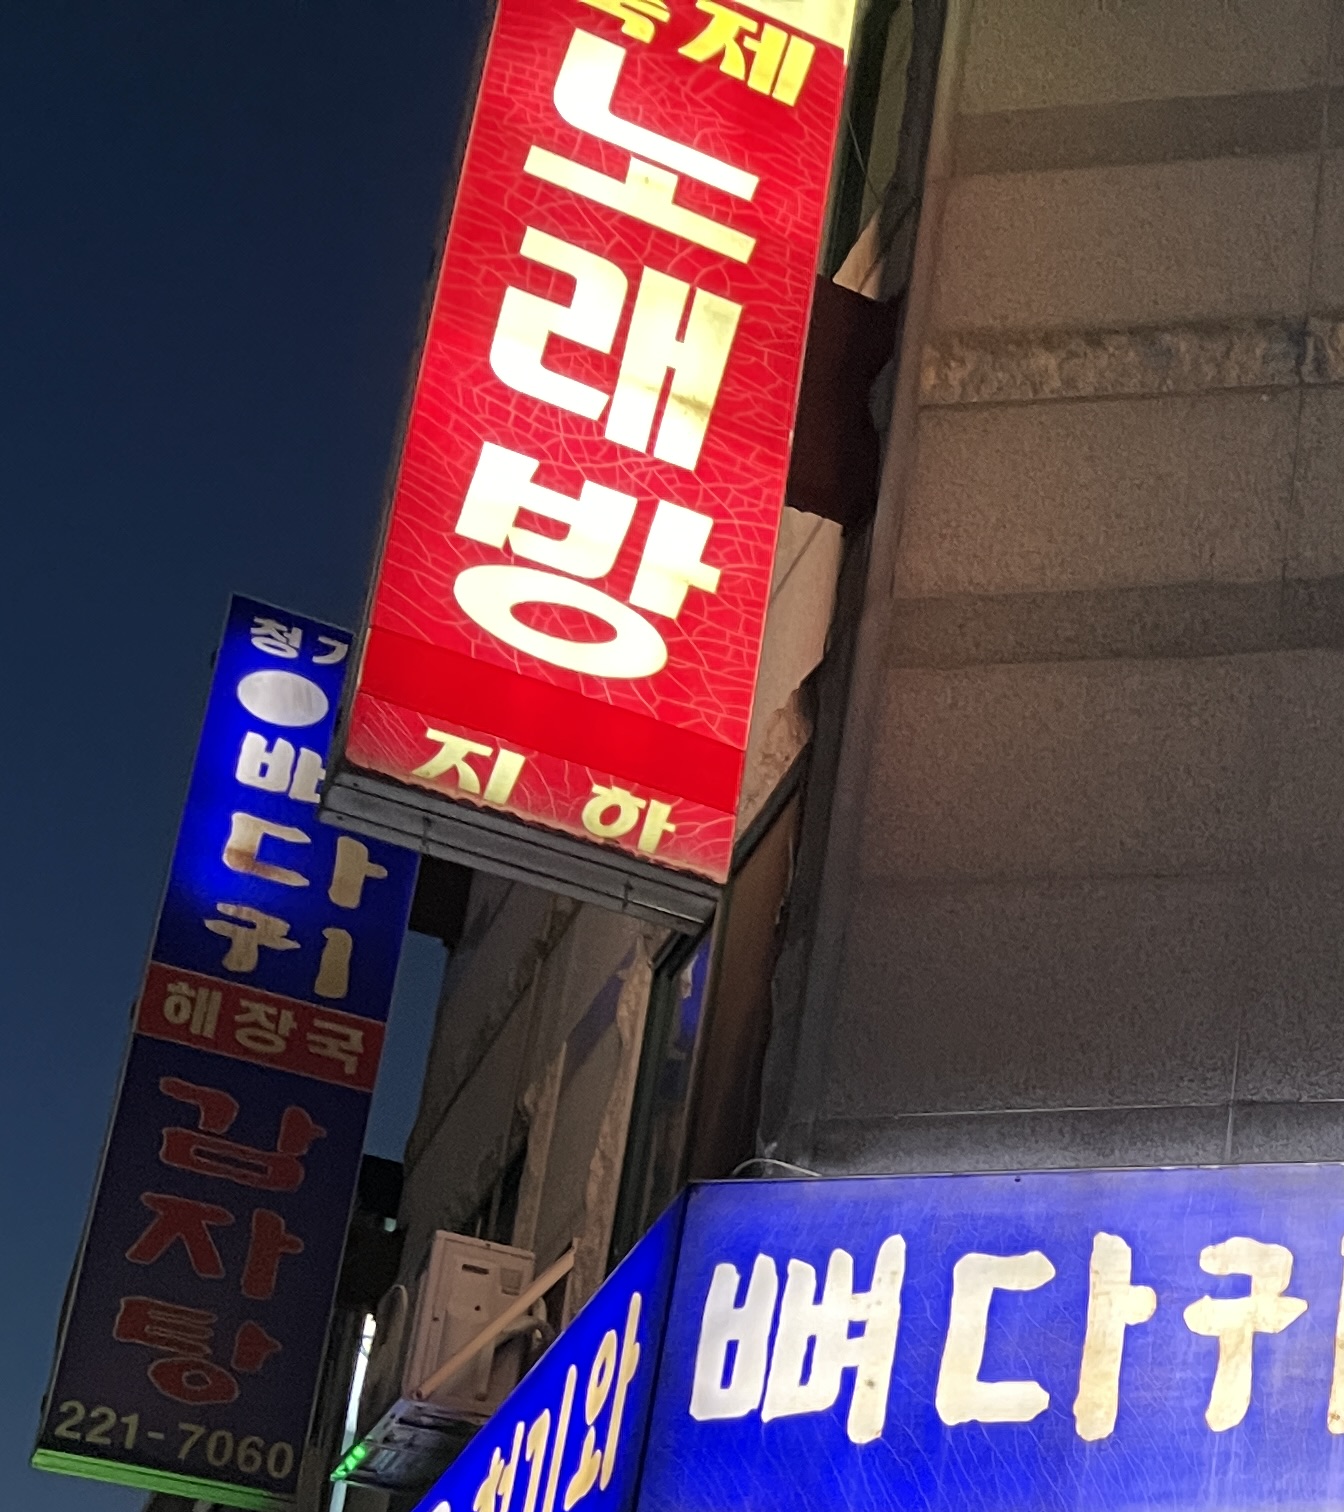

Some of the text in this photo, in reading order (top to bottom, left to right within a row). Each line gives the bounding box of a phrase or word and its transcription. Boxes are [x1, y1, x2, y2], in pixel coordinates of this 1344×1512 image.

[453, 27, 760, 681] 노래방
[162, 980, 367, 1077] 해장국
[113, 1076, 327, 1405] 감자탕
[53, 1399, 295, 1480] 221-7060
